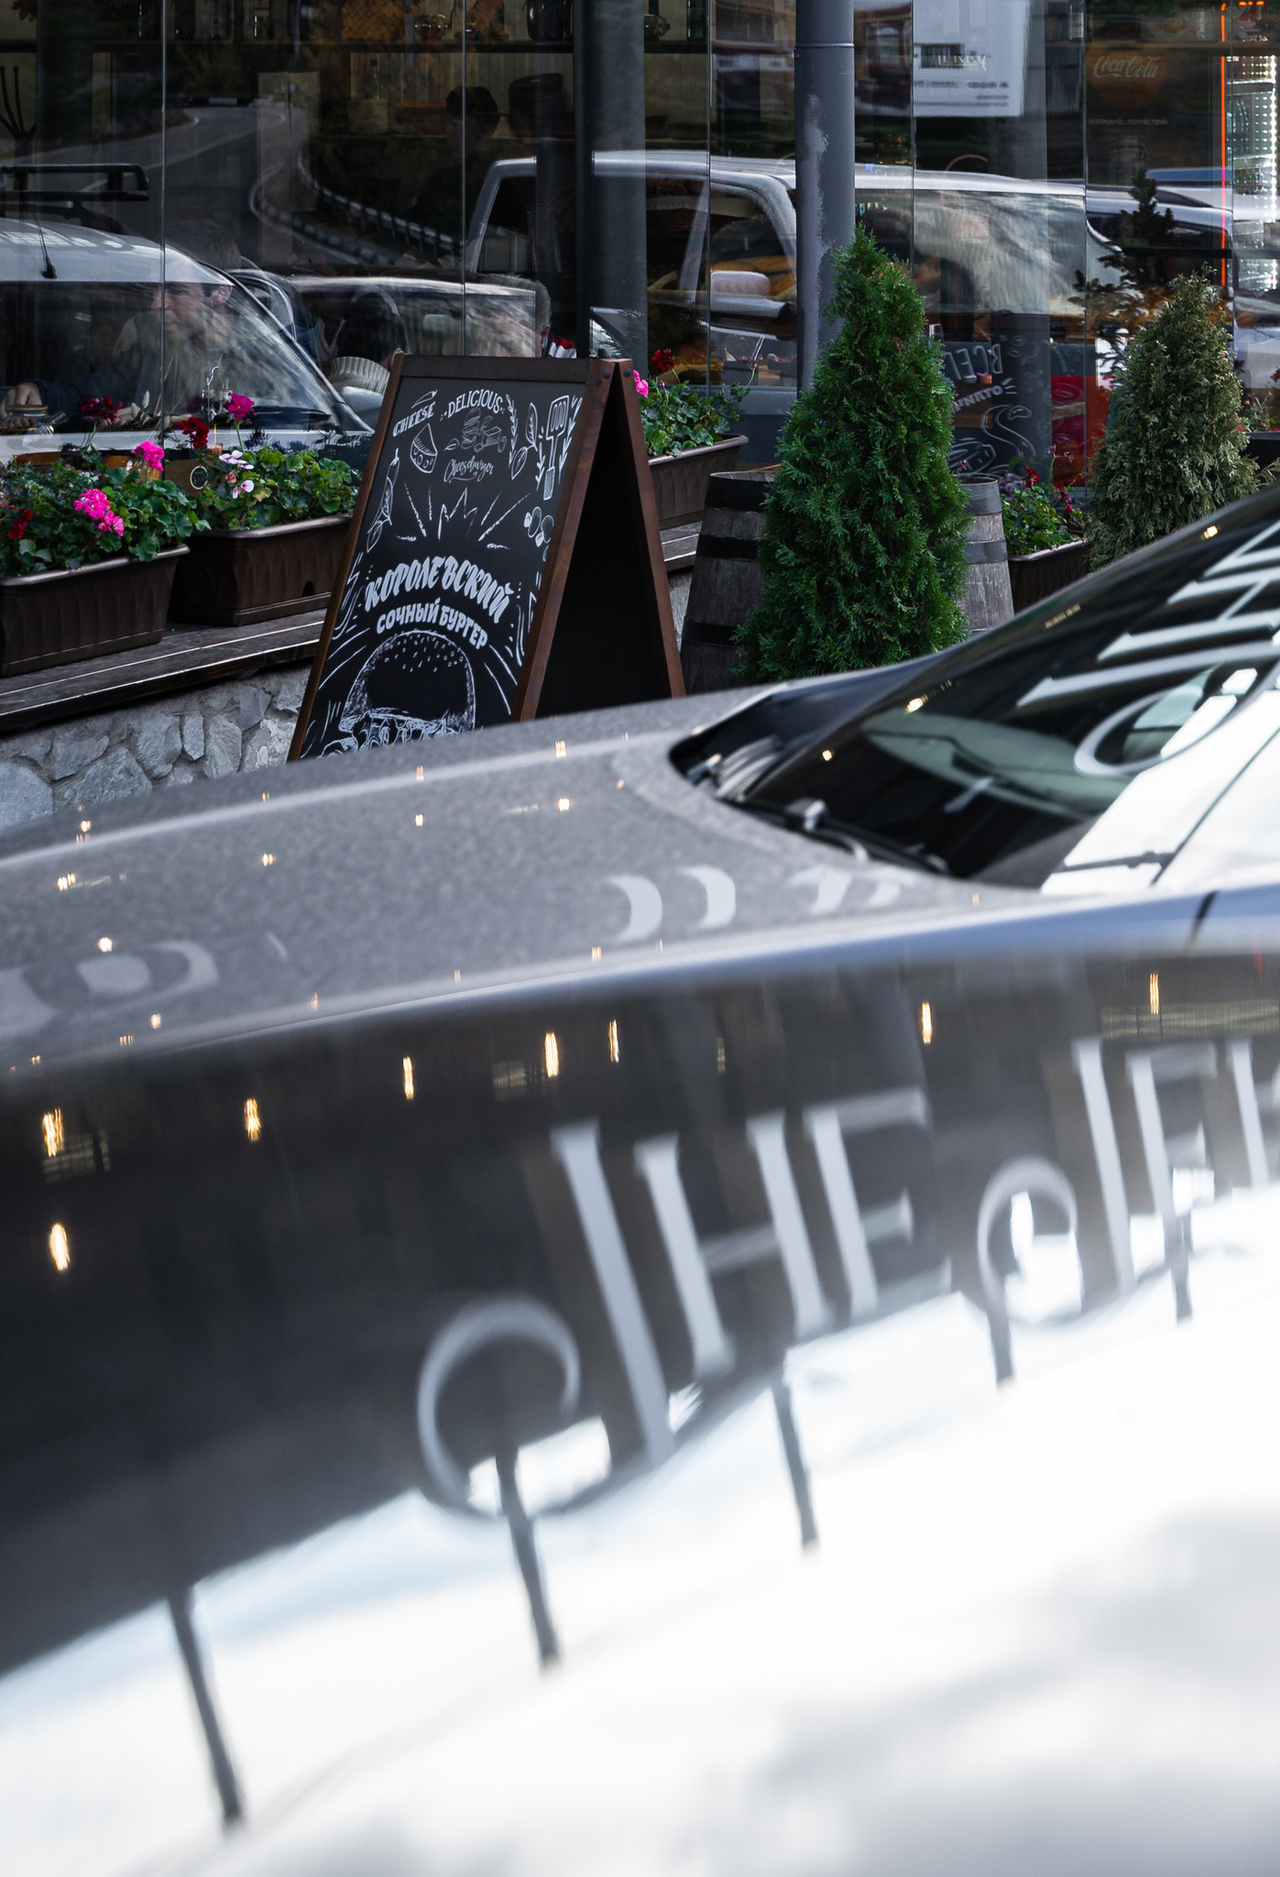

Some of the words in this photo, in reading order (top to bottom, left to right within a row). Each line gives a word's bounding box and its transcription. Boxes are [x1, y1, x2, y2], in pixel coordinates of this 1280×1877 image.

[392, 400, 436, 437] CHEESE
[447, 388, 504, 419] DELICIOUS
[364, 555, 514, 624] КОРОЛЕВСКИЙ
[376, 597, 441, 634] СОЧНЫЙ
[438, 605, 489, 650] БУРГЕР
